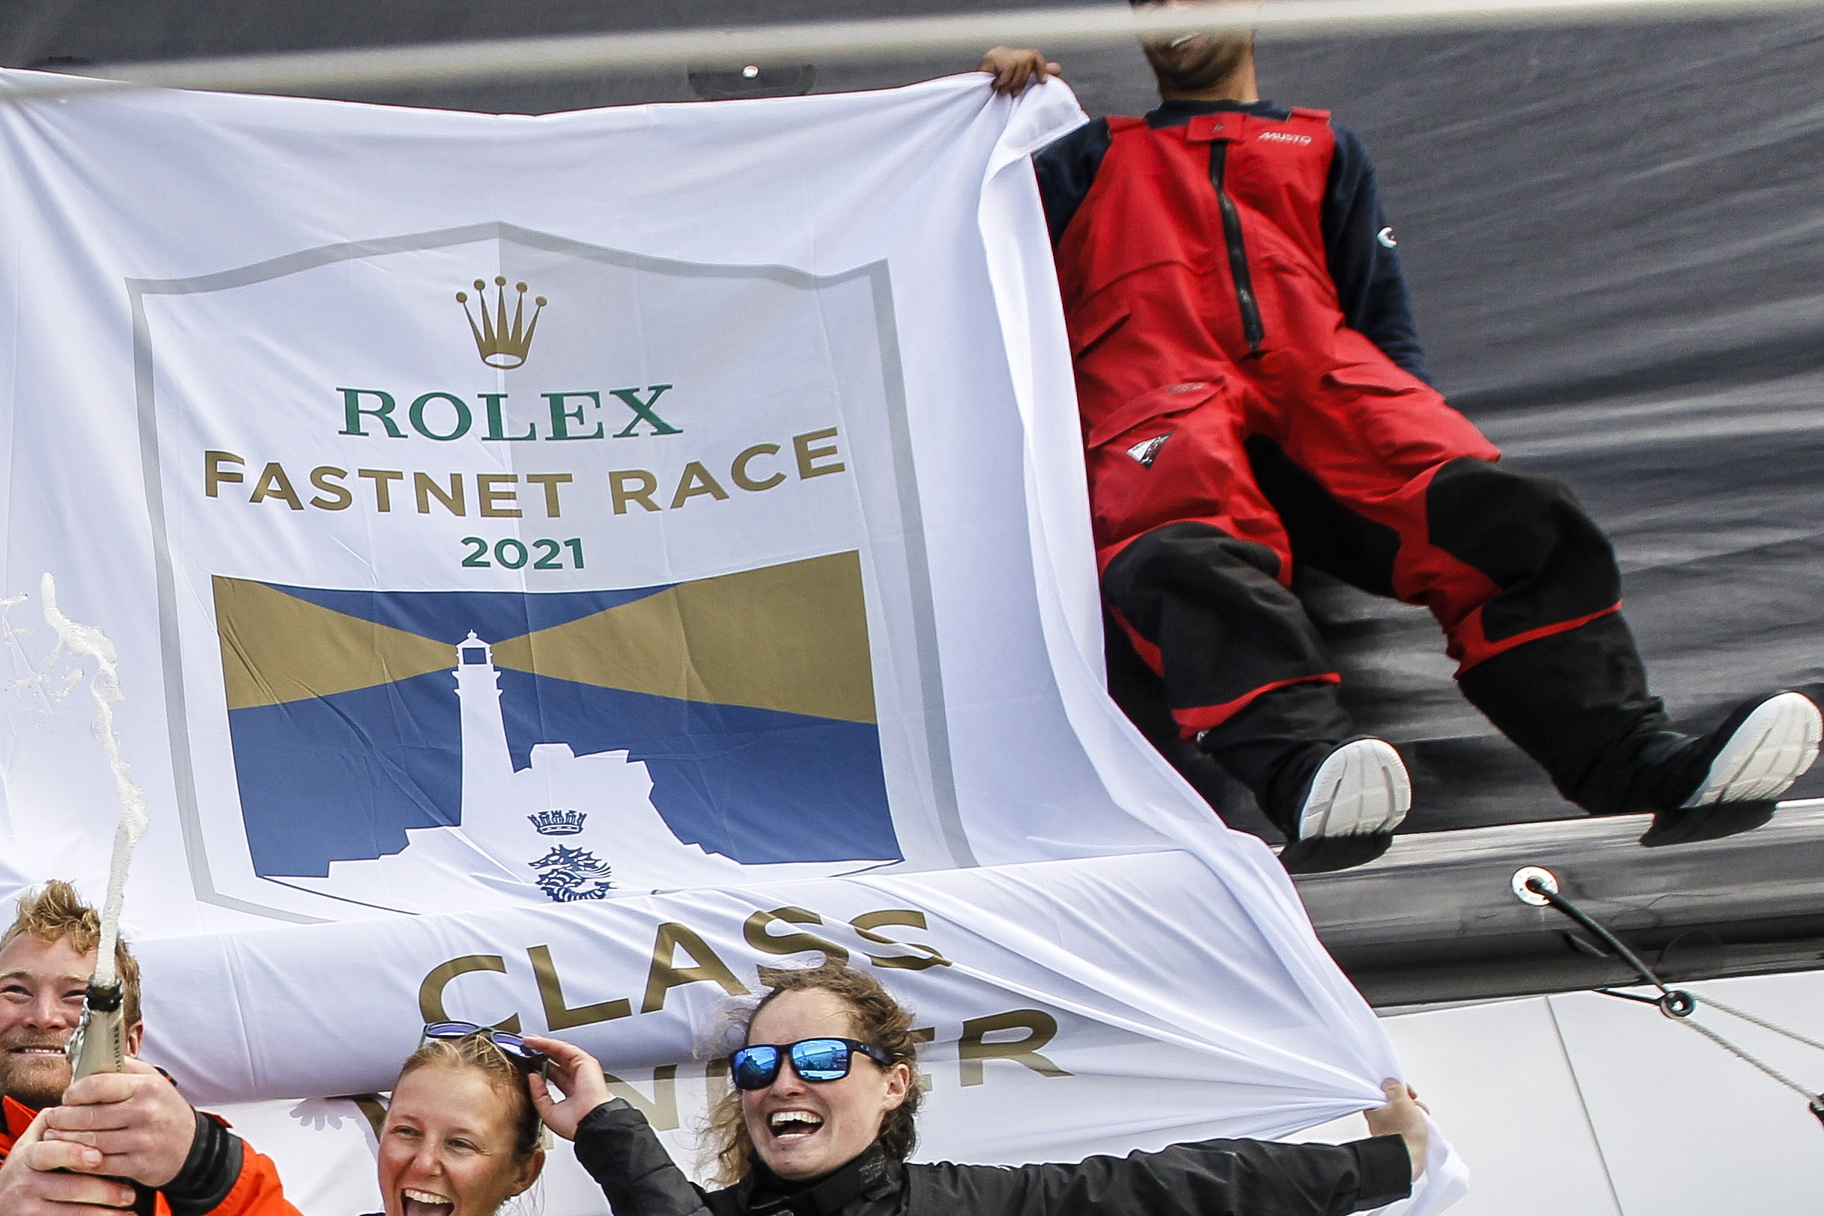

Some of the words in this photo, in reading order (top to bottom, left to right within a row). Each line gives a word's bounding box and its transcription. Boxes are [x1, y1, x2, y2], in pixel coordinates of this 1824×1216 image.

[336, 384, 684, 441] ROLEX
[204, 450, 573, 518] FASTNET
[608, 426, 846, 515] RACE
[460, 537, 585, 571] 2021
[417, 907, 952, 1034] CLASS
